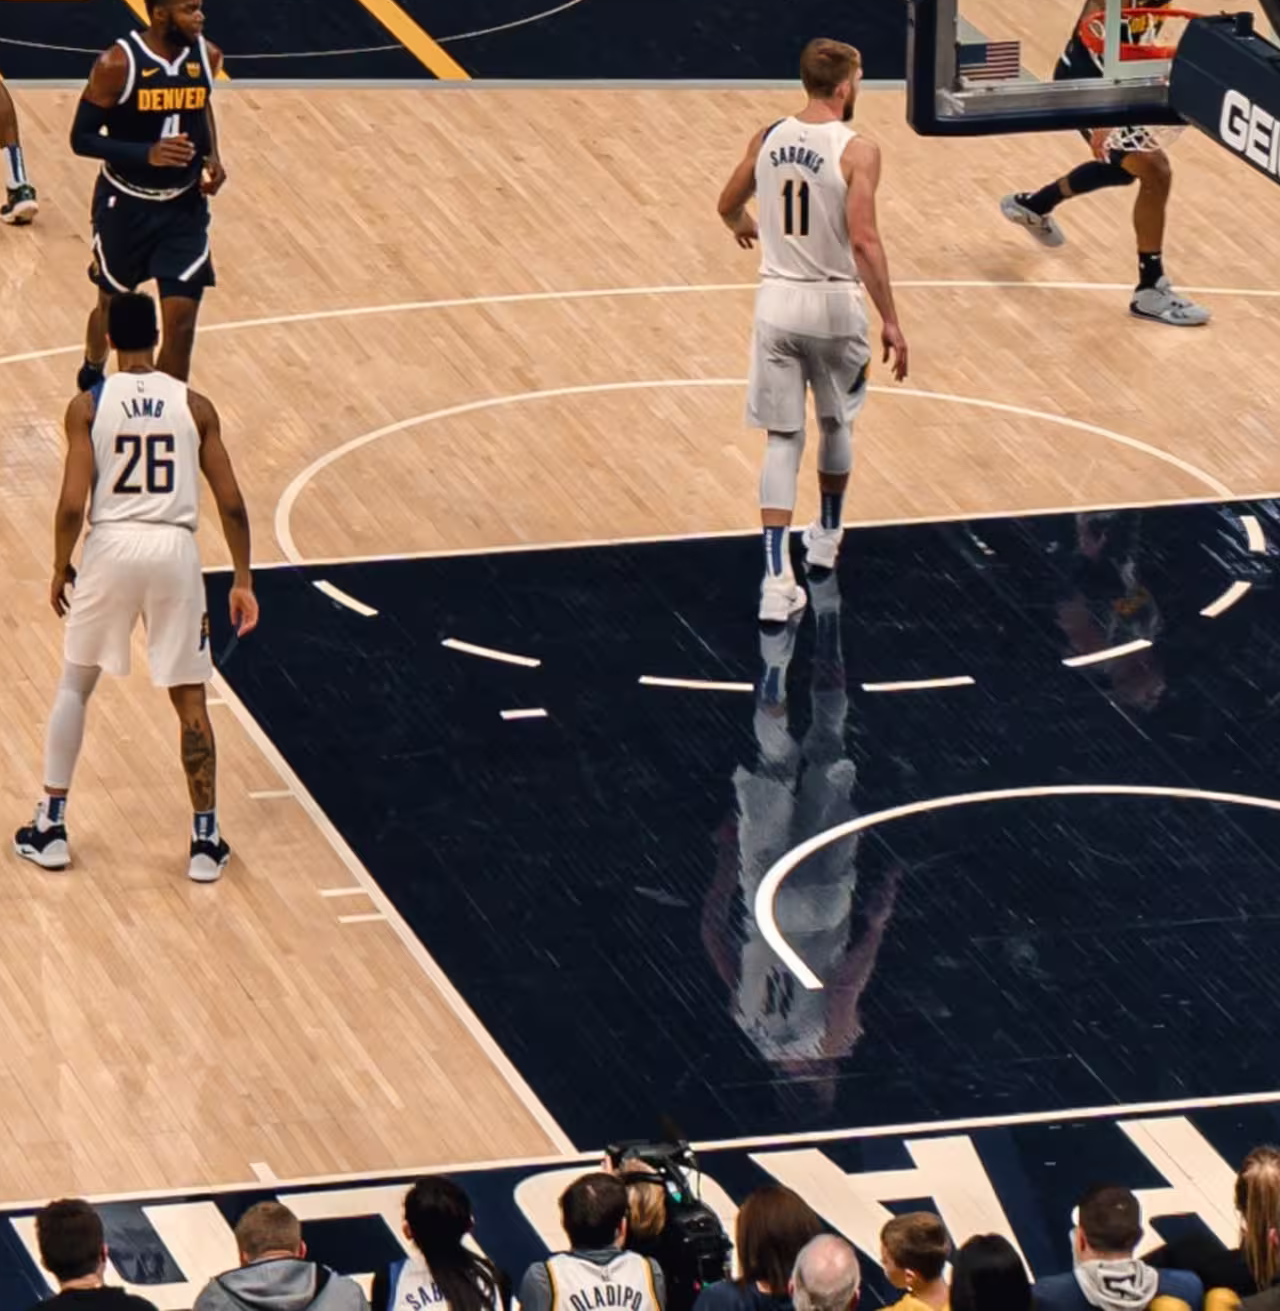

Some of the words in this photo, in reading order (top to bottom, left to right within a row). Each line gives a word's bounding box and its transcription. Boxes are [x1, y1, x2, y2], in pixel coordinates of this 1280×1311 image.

[137, 86, 207, 111] DENVER
[770, 145, 825, 174] SABONIS
[782, 179, 809, 237] 11
[121, 397, 165, 420] LAMB
[112, 433, 176, 496] 26
